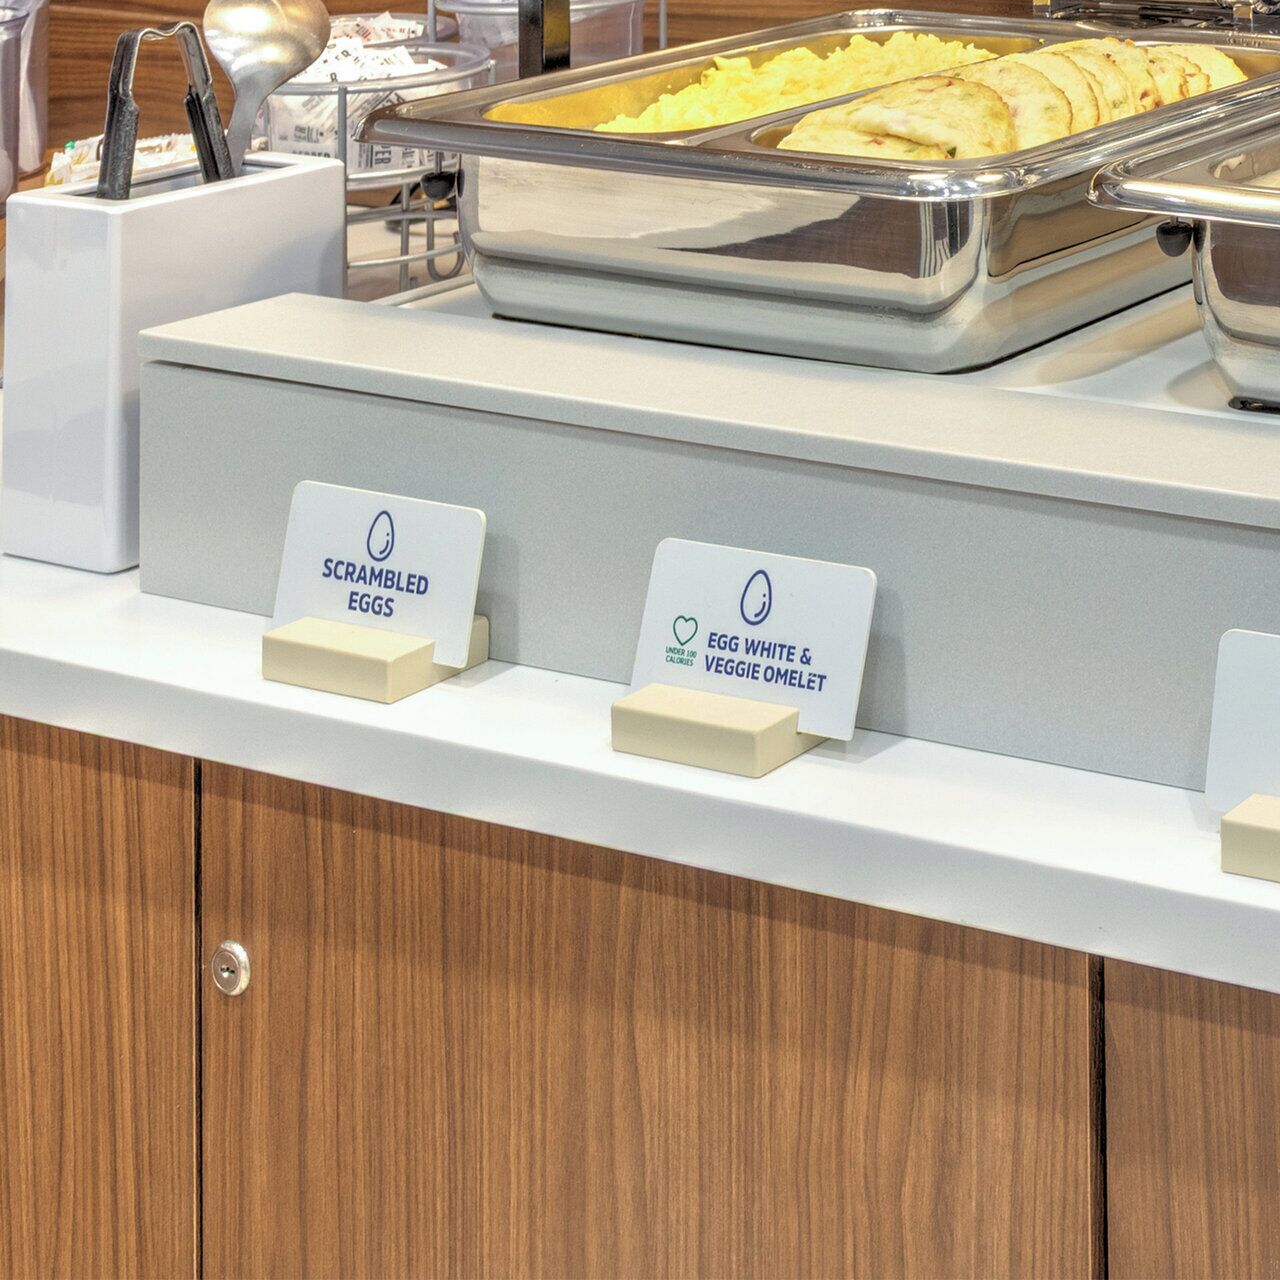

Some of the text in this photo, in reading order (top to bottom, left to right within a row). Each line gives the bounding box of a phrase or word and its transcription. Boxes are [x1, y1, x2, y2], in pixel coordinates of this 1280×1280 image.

[322, 558, 429, 595] SCRAMBLED
[347, 591, 395, 617] EGGS
[665, 646, 697, 658] UNDER 100
[665, 655, 694, 667] CALORIES
[707, 632, 812, 666] EGG WHITE &
[705, 655, 827, 692] VEGGIE OMELET
